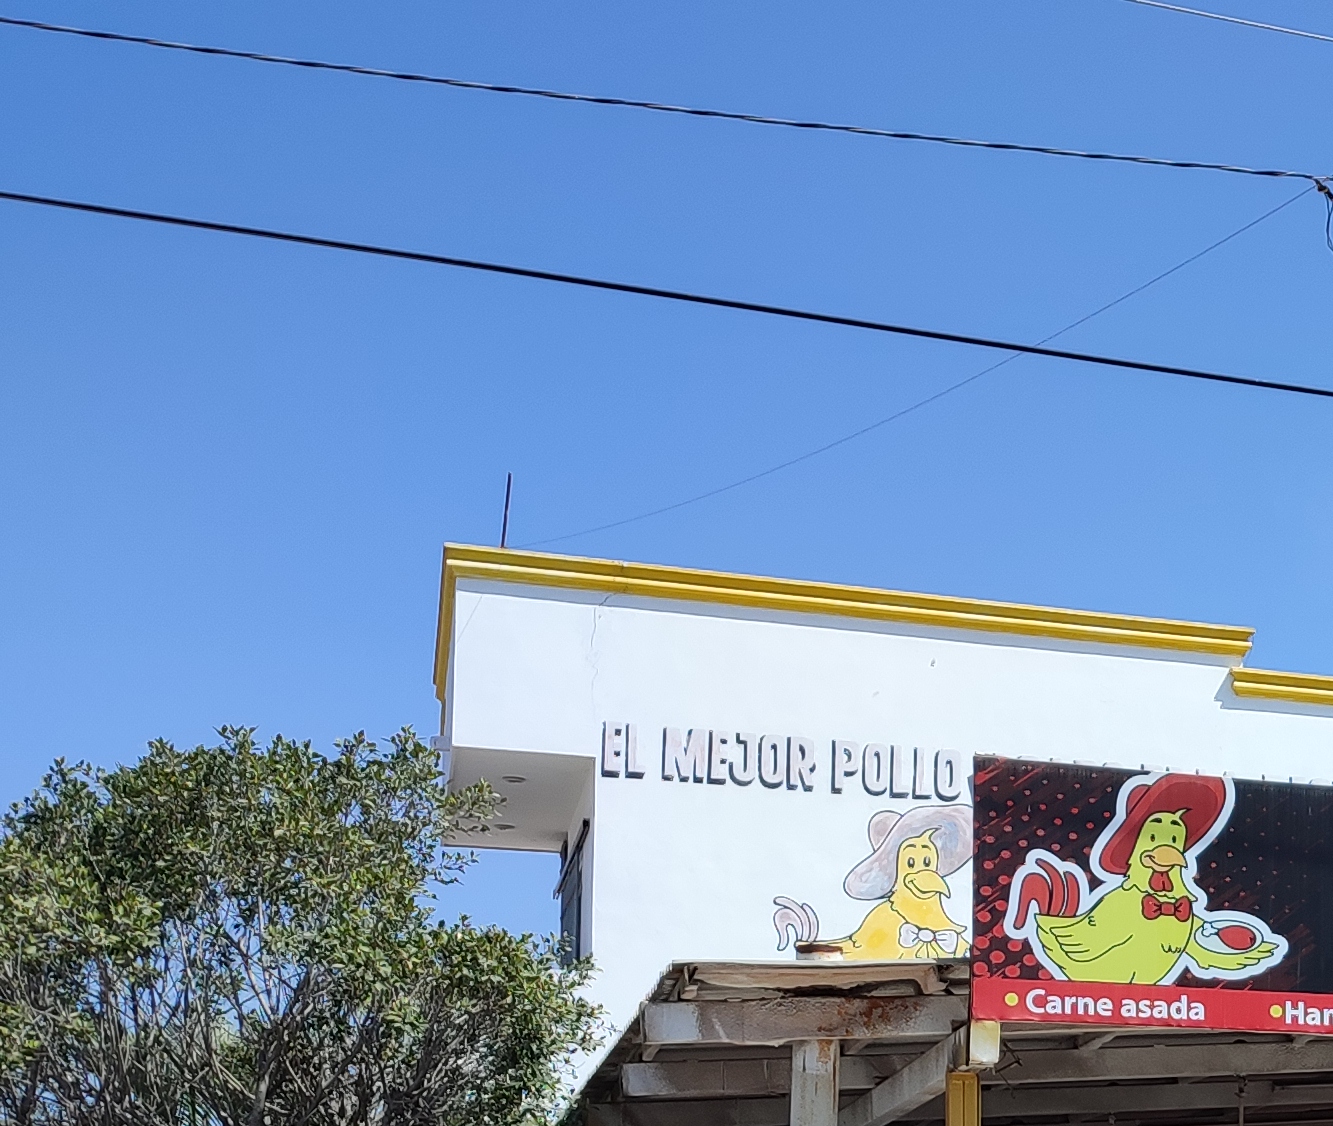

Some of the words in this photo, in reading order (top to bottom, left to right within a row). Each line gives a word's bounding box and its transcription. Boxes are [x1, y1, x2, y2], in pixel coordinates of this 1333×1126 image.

[601, 721, 645, 779] EL
[662, 726, 816, 791] MEJOR
[830, 739, 963, 802] POLLO
[1025, 988, 1114, 1016] Carne
[1120, 994, 1205, 1021] asada
